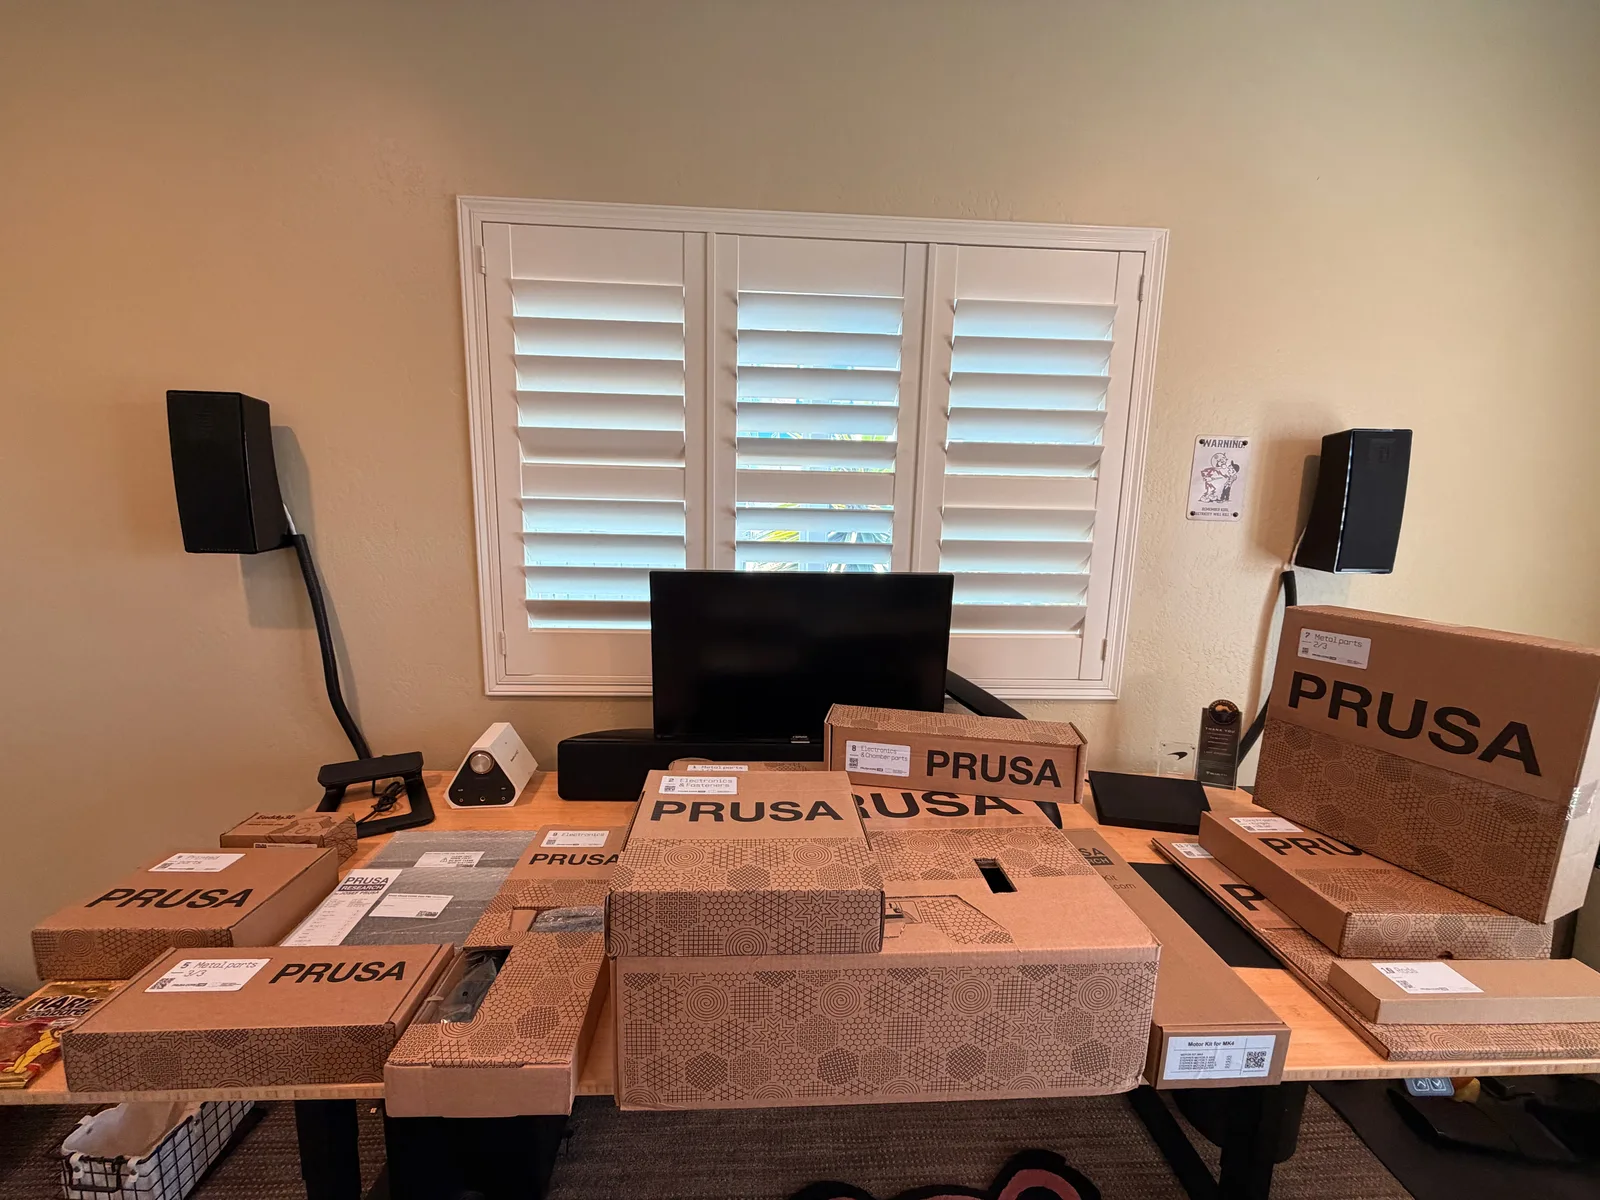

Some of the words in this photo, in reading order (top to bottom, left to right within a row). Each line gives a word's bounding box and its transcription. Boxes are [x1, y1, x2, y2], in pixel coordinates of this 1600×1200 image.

[1313, 641, 1328, 650] 2/3
[1288, 670, 1542, 776] PRUSA
[860, 746, 897, 754] Electronics
[926, 750, 1062, 788] PRUSA
[650, 800, 844, 822] PRUSA
[1257, 838, 1363, 856] PRU
[528, 854, 620, 866] PRUSA
[84, 888, 254, 908] PRUSA
[268, 961, 406, 984] PRUSA
